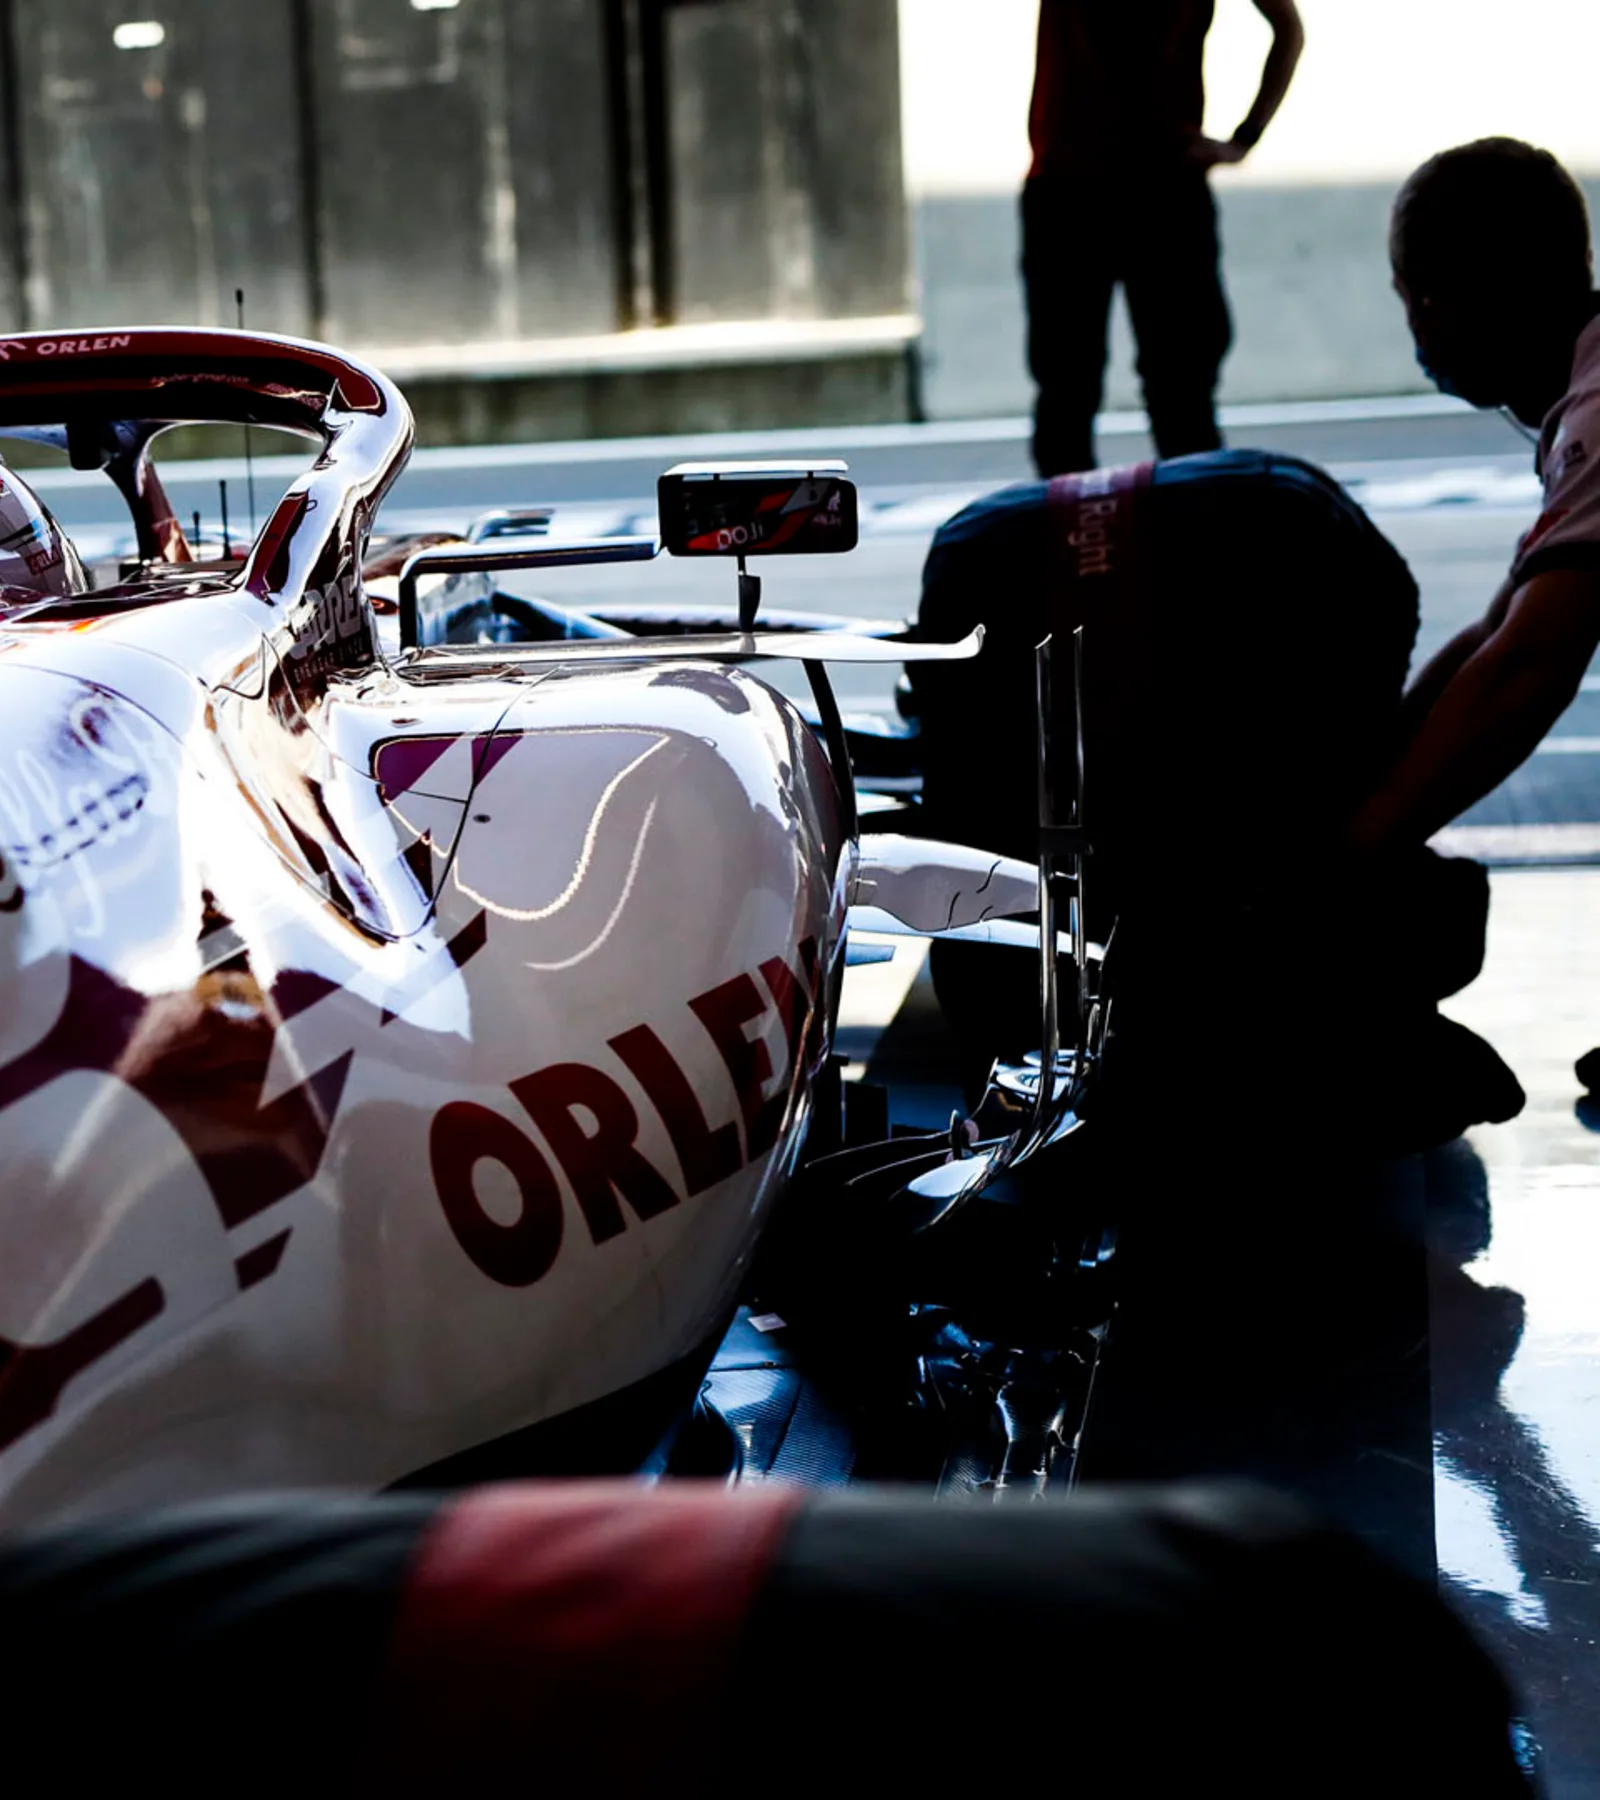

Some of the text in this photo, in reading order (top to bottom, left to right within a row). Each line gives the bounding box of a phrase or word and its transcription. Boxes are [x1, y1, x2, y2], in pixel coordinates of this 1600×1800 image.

[37, 334, 132, 355] ORLEN
[1066, 498, 1118, 578] Right
[430, 936, 827, 1287] ORLEN
